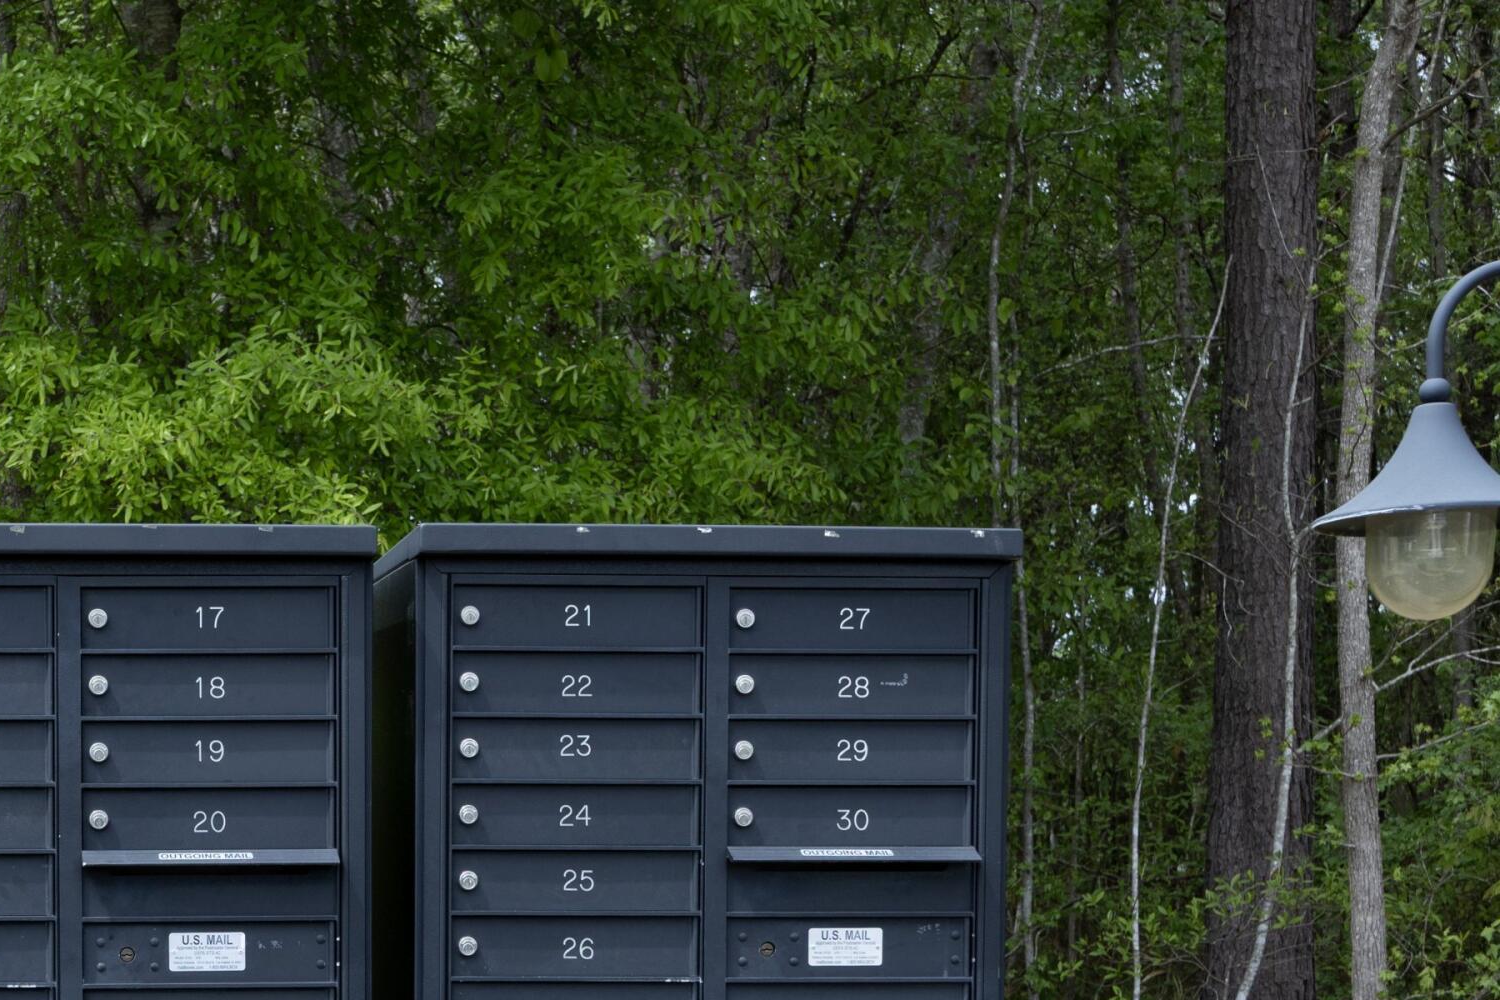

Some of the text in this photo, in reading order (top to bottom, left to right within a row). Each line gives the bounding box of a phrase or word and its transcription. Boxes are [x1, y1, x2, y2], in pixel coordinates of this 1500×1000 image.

[195, 606, 225, 629] 17
[564, 604, 591, 627] 21
[839, 607, 871, 630] 27
[195, 676, 225, 699] 18
[561, 674, 593, 697] 22
[837, 675, 870, 699] 28
[195, 739, 225, 763] 19
[559, 734, 592, 757] 23
[837, 739, 869, 762] 29
[193, 810, 226, 833] 20
[559, 804, 592, 827] 24
[836, 808, 869, 831] 30
[563, 869, 595, 892] 25
[181, 934, 233, 945] U.S. MAIL
[821, 929, 871, 940] U.S. MAIL
[562, 937, 594, 960] 26
